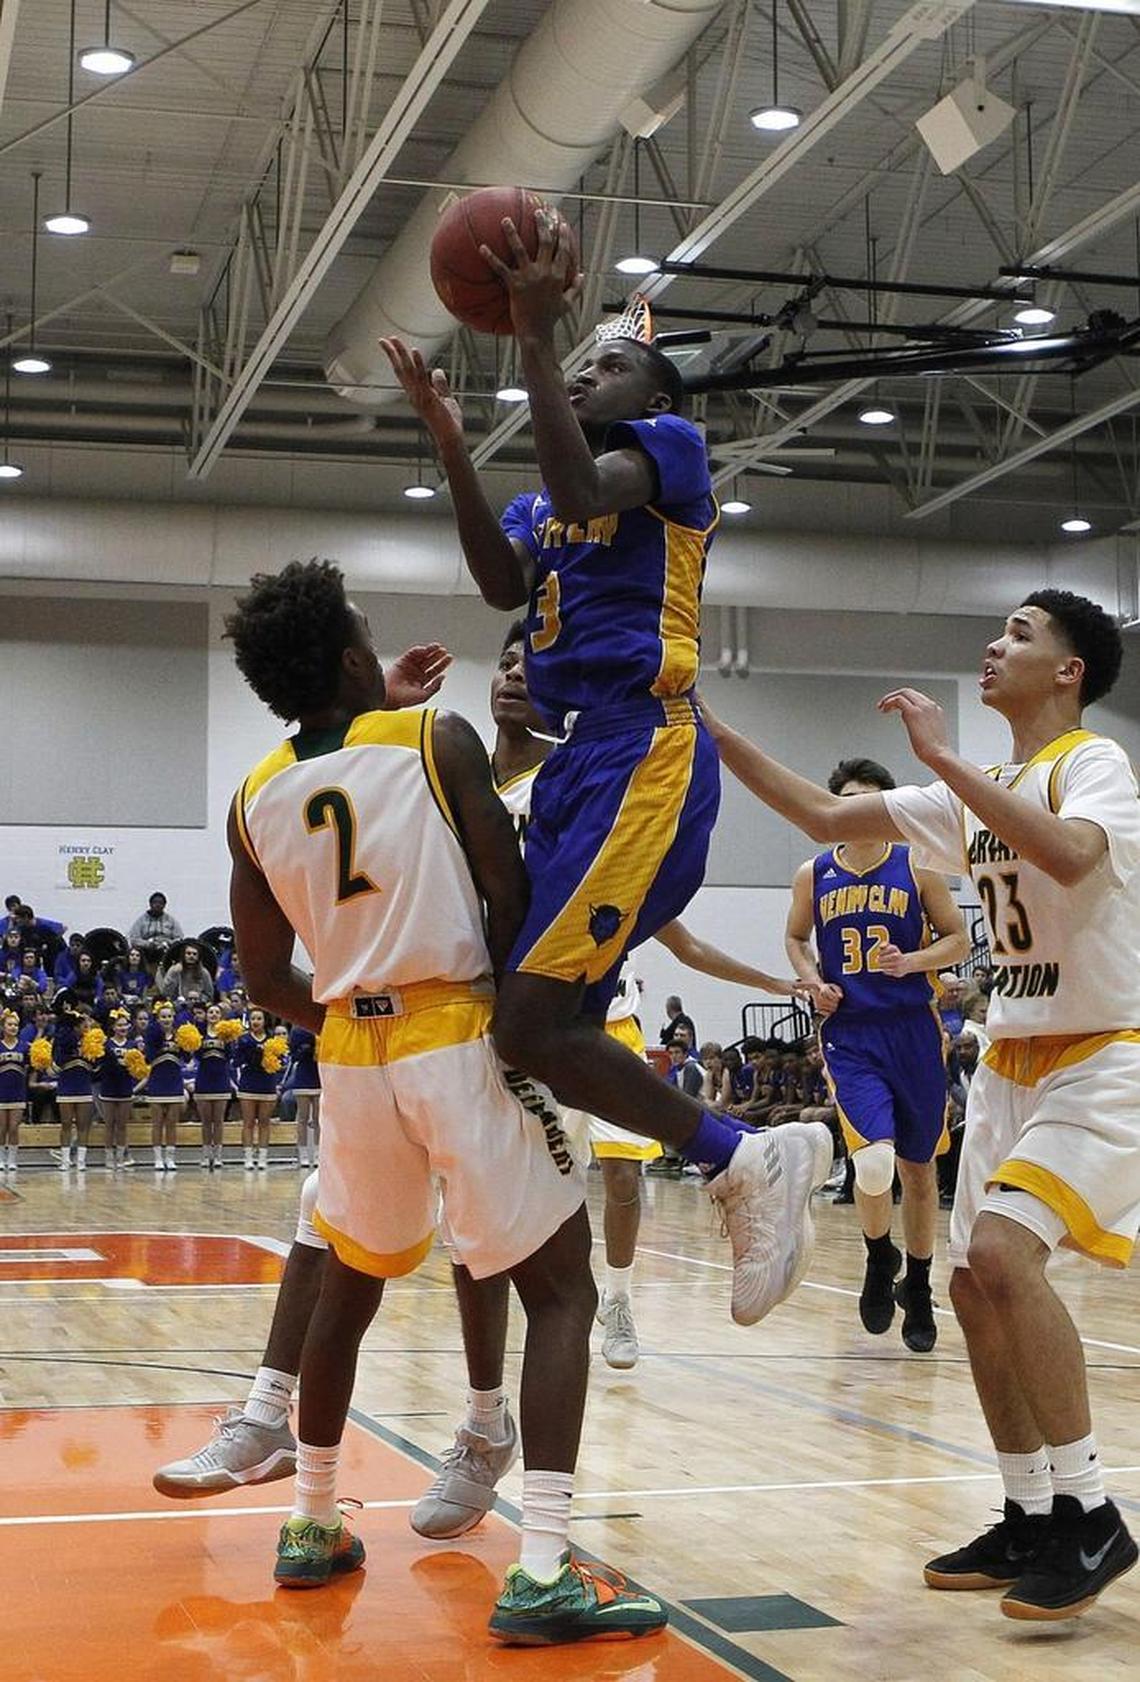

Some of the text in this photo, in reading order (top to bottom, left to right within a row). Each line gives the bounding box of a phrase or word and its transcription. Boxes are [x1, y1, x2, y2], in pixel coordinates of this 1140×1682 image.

[530, 569, 562, 653] 3
[58, 845, 114, 855] HENRY CLAY
[303, 785, 382, 906] 2
[819, 884, 910, 927] HENRY CLAY
[976, 872, 1034, 956] 23
[841, 924, 890, 975] 32
